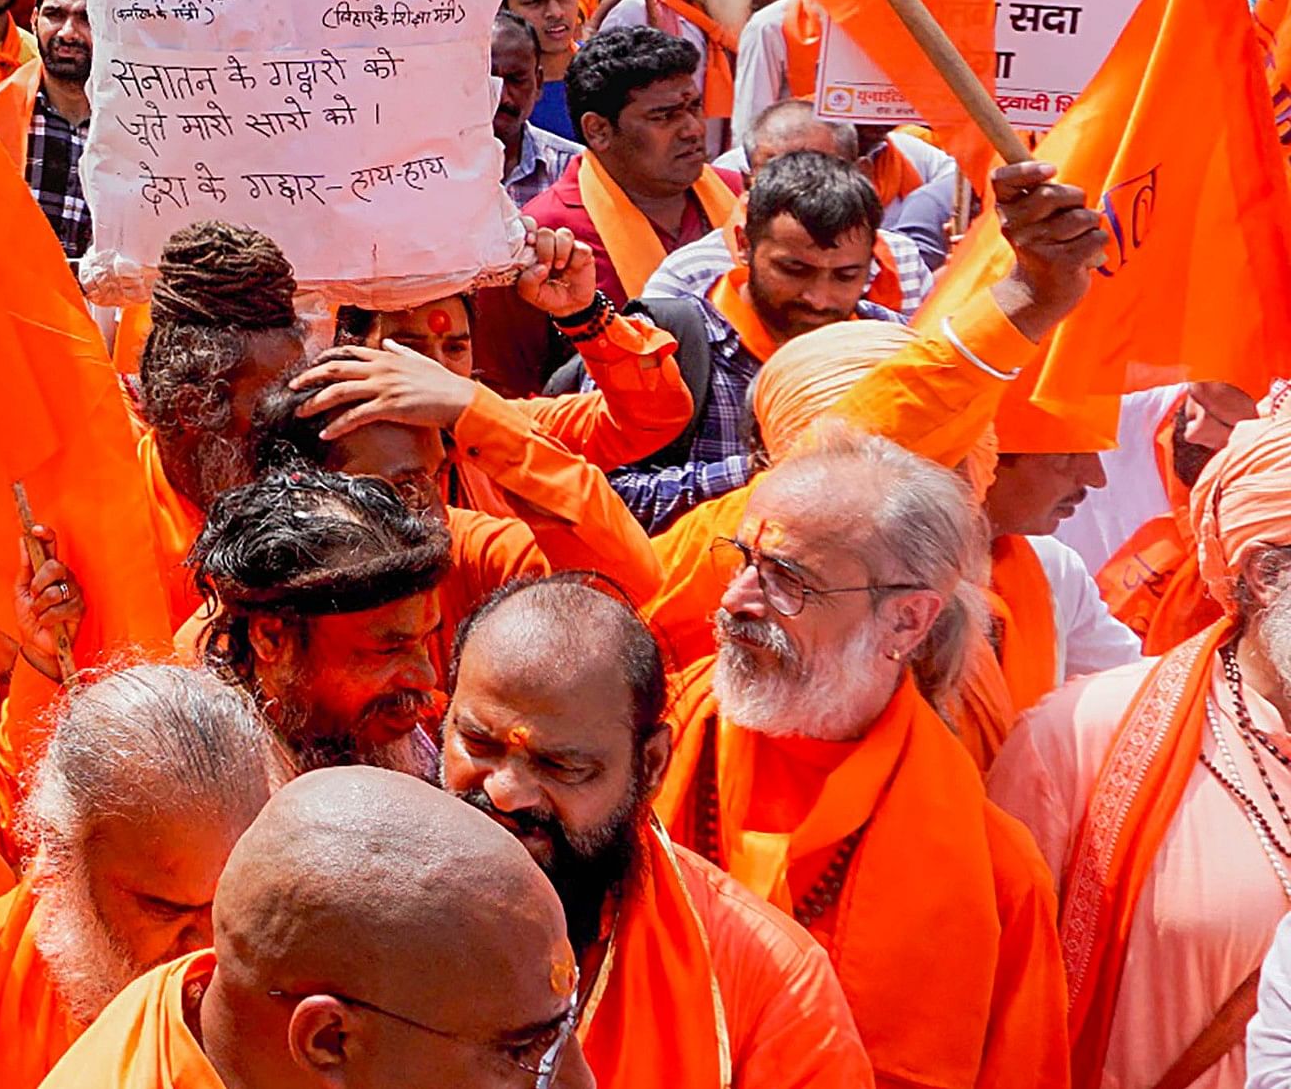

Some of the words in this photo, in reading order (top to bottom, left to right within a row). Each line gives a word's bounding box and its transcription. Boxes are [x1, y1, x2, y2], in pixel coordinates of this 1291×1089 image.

[1009, 2, 1082, 35] सदा
[112, 59, 217, 100] सनातन
[223, 55, 258, 89] के
[363, 47, 405, 80] को
[177, 101, 234, 141] मारो
[321, 93, 359, 124] को
[196, 162, 227, 204] के
